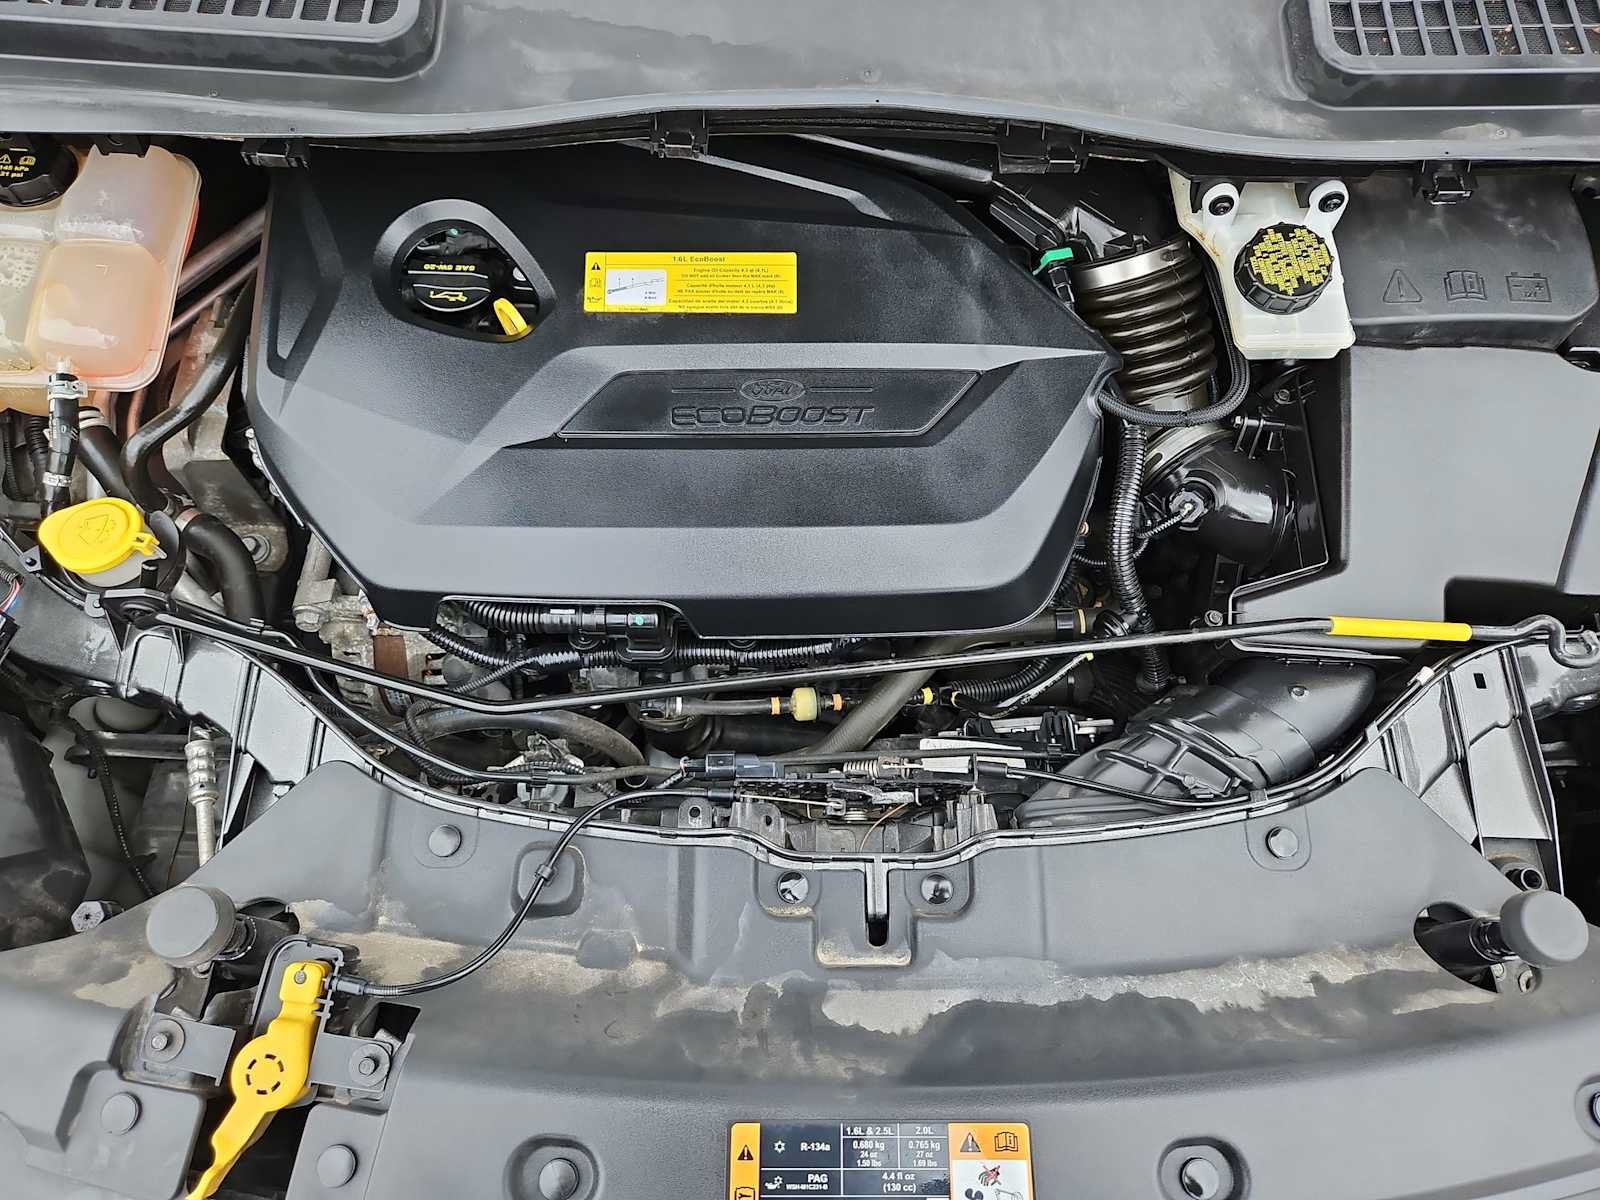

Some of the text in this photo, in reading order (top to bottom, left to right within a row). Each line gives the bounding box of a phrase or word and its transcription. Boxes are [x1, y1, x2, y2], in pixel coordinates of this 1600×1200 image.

[846, 1126, 894, 1135] 1.6L & 2.5L
[915, 1126, 934, 1135] 2.0L
[800, 1142, 831, 1152] R-134a
[852, 1140, 885, 1151] 0.680 kg
[908, 1140, 940, 1151] 0.765 kg
[871, 1159, 882, 1167] lbs
[927, 1159, 937, 1167] lbs
[808, 1173, 828, 1183] PAG
[882, 1172, 895, 1180] 4.4
[905, 1172, 915, 1180] oz
[883, 1182, 917, 1193] (130 cc)
